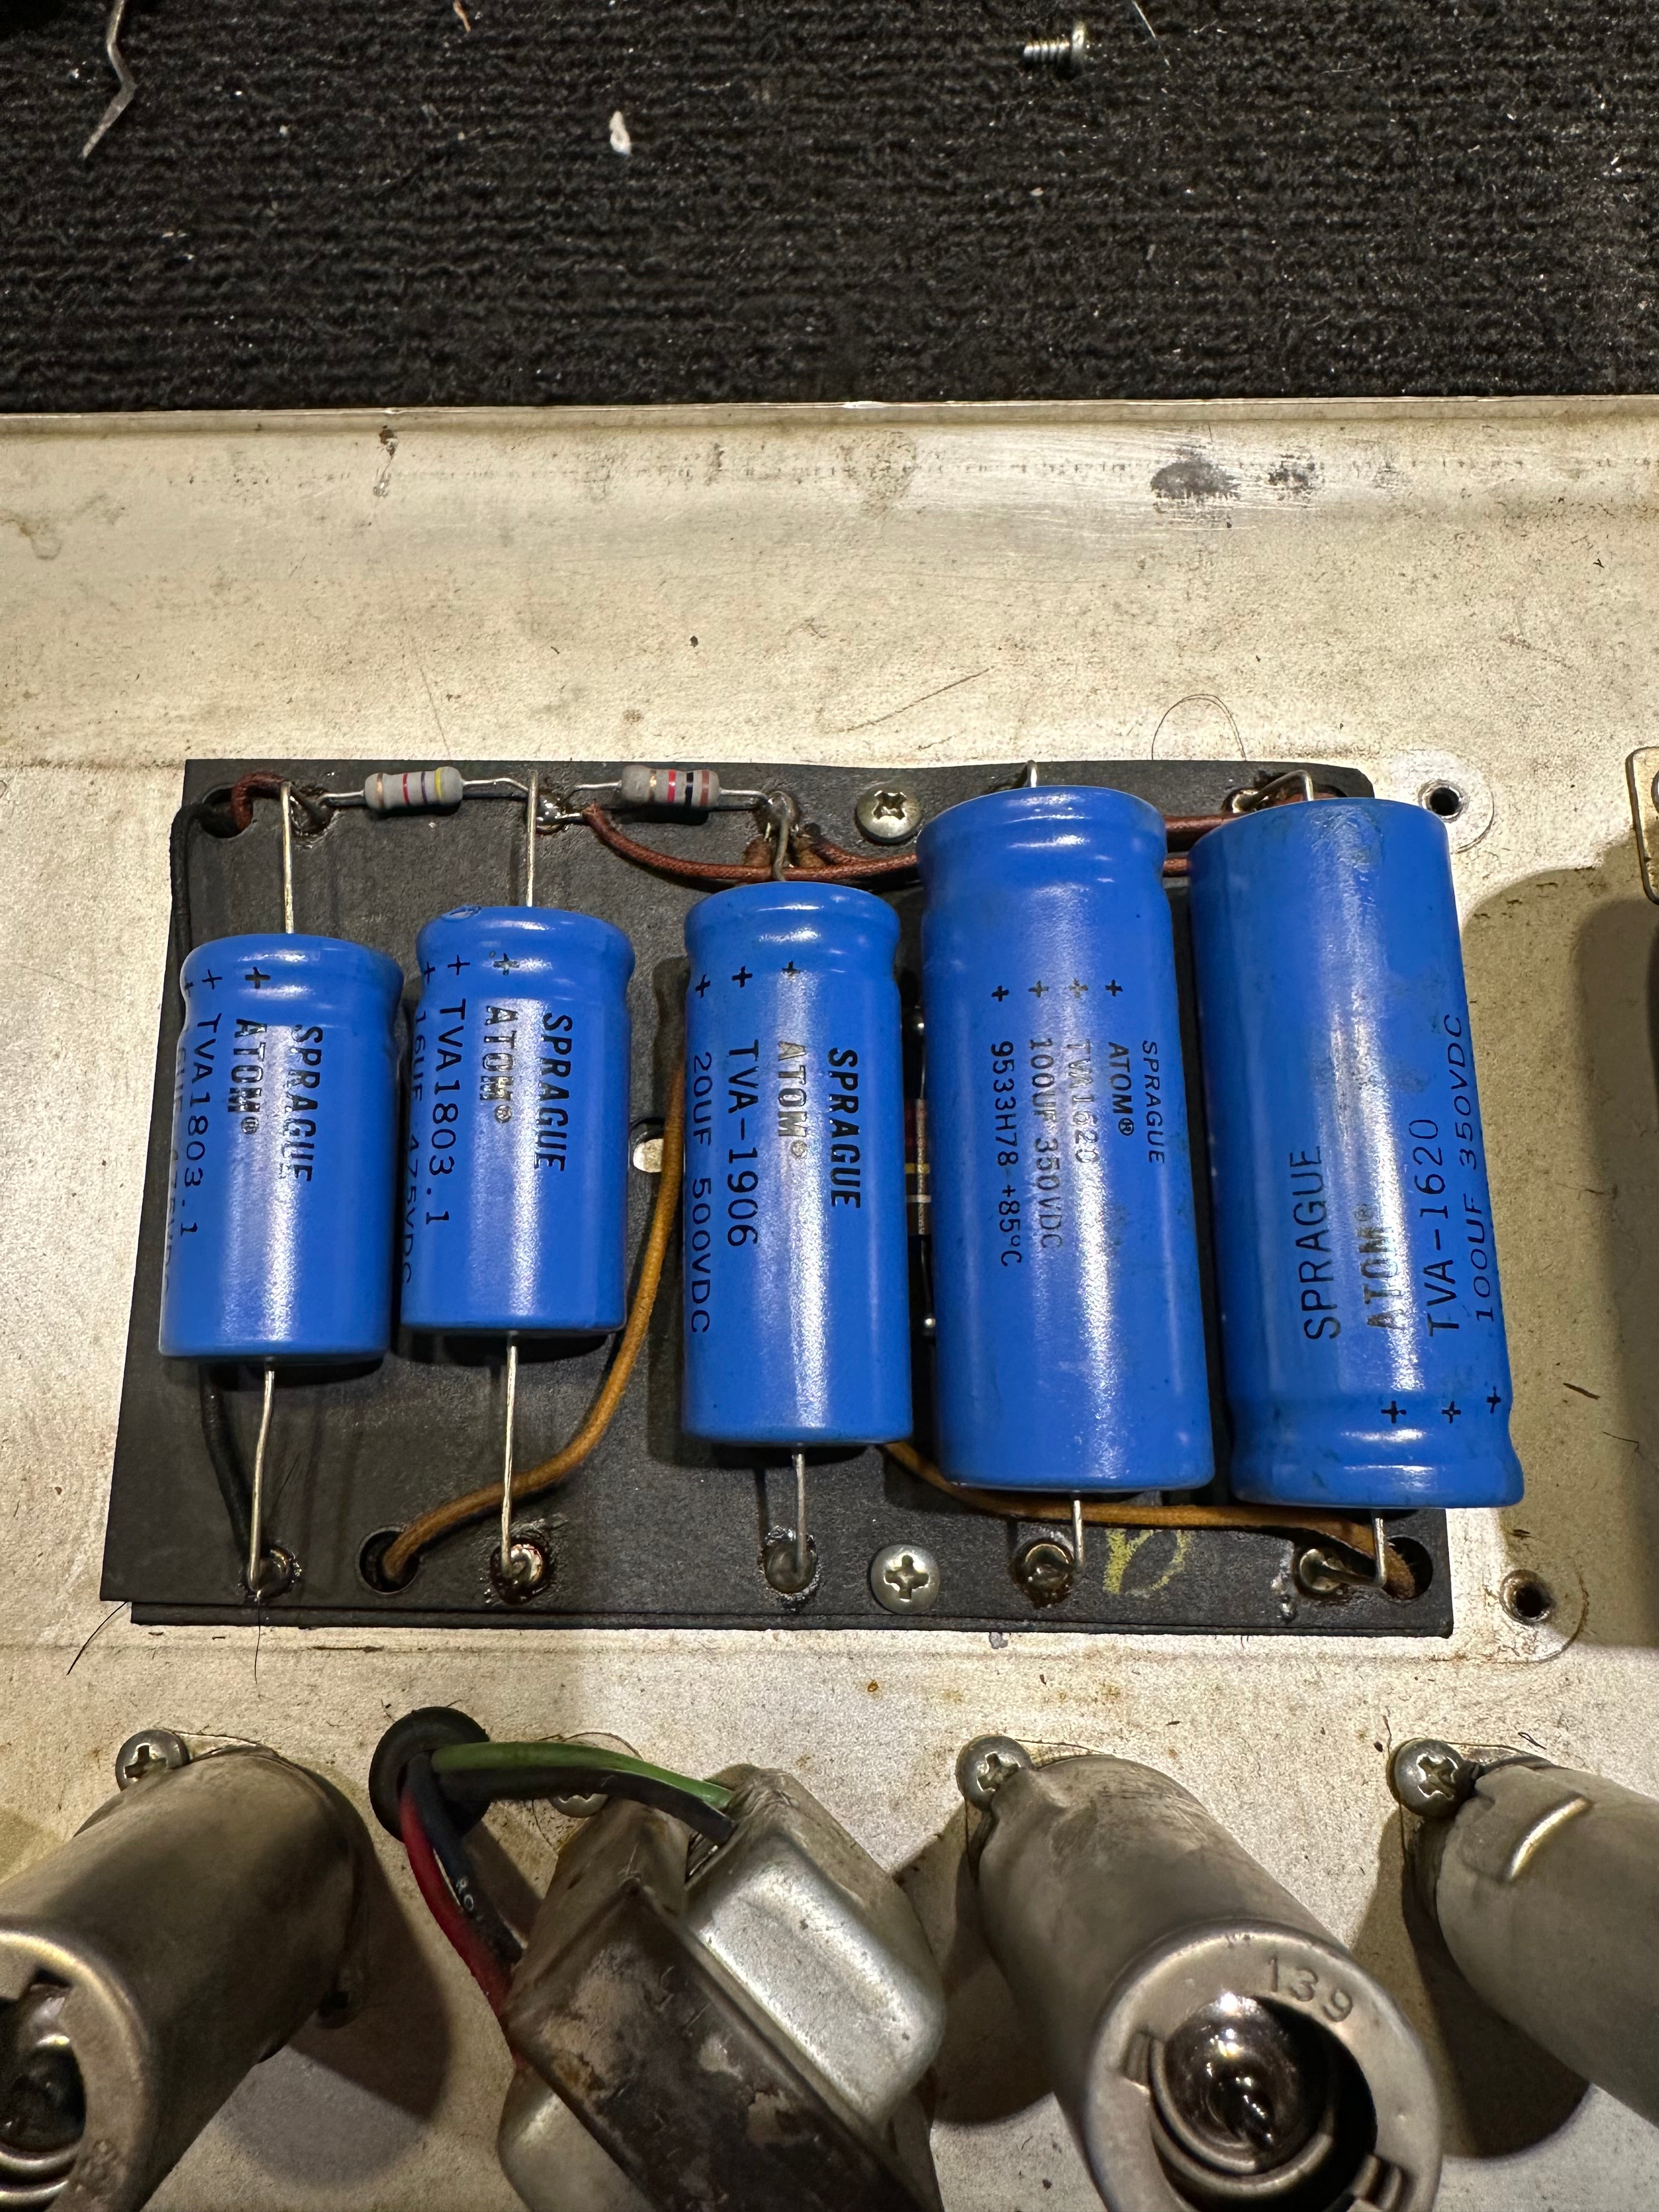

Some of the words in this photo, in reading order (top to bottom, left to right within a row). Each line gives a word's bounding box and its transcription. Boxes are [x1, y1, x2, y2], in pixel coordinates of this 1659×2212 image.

[180, 1012, 222, 1237] TVA1803.1
[279, 1024, 324, 1182] SPRAGUE
[426, 998, 467, 1225] TVA1803.1
[534, 1012, 573, 1172] SPRAGUE
[692, 1051, 713, 1146] 20UF
[727, 1039, 759, 1247] TVA-1906
[828, 1047, 861, 1209] SPRAGUE
[991, 1040, 1019, 1167] 9533H78
[1029, 1037, 1057, 1123] 100UF
[1142, 1040, 1165, 1164] SPRAGUE
[1443, 1014, 1477, 1171] 350VDC
[691, 1177, 712, 1334] 500VDC
[1035, 1137, 1063, 1249] 350VDC
[1290, 1145, 1341, 1340] SPRAGUE
[1408, 1119, 1460, 1338] TVA-1620
[1463, 1193, 1495, 1323] 100UF
[1267, 1955, 1353, 2023] 139
